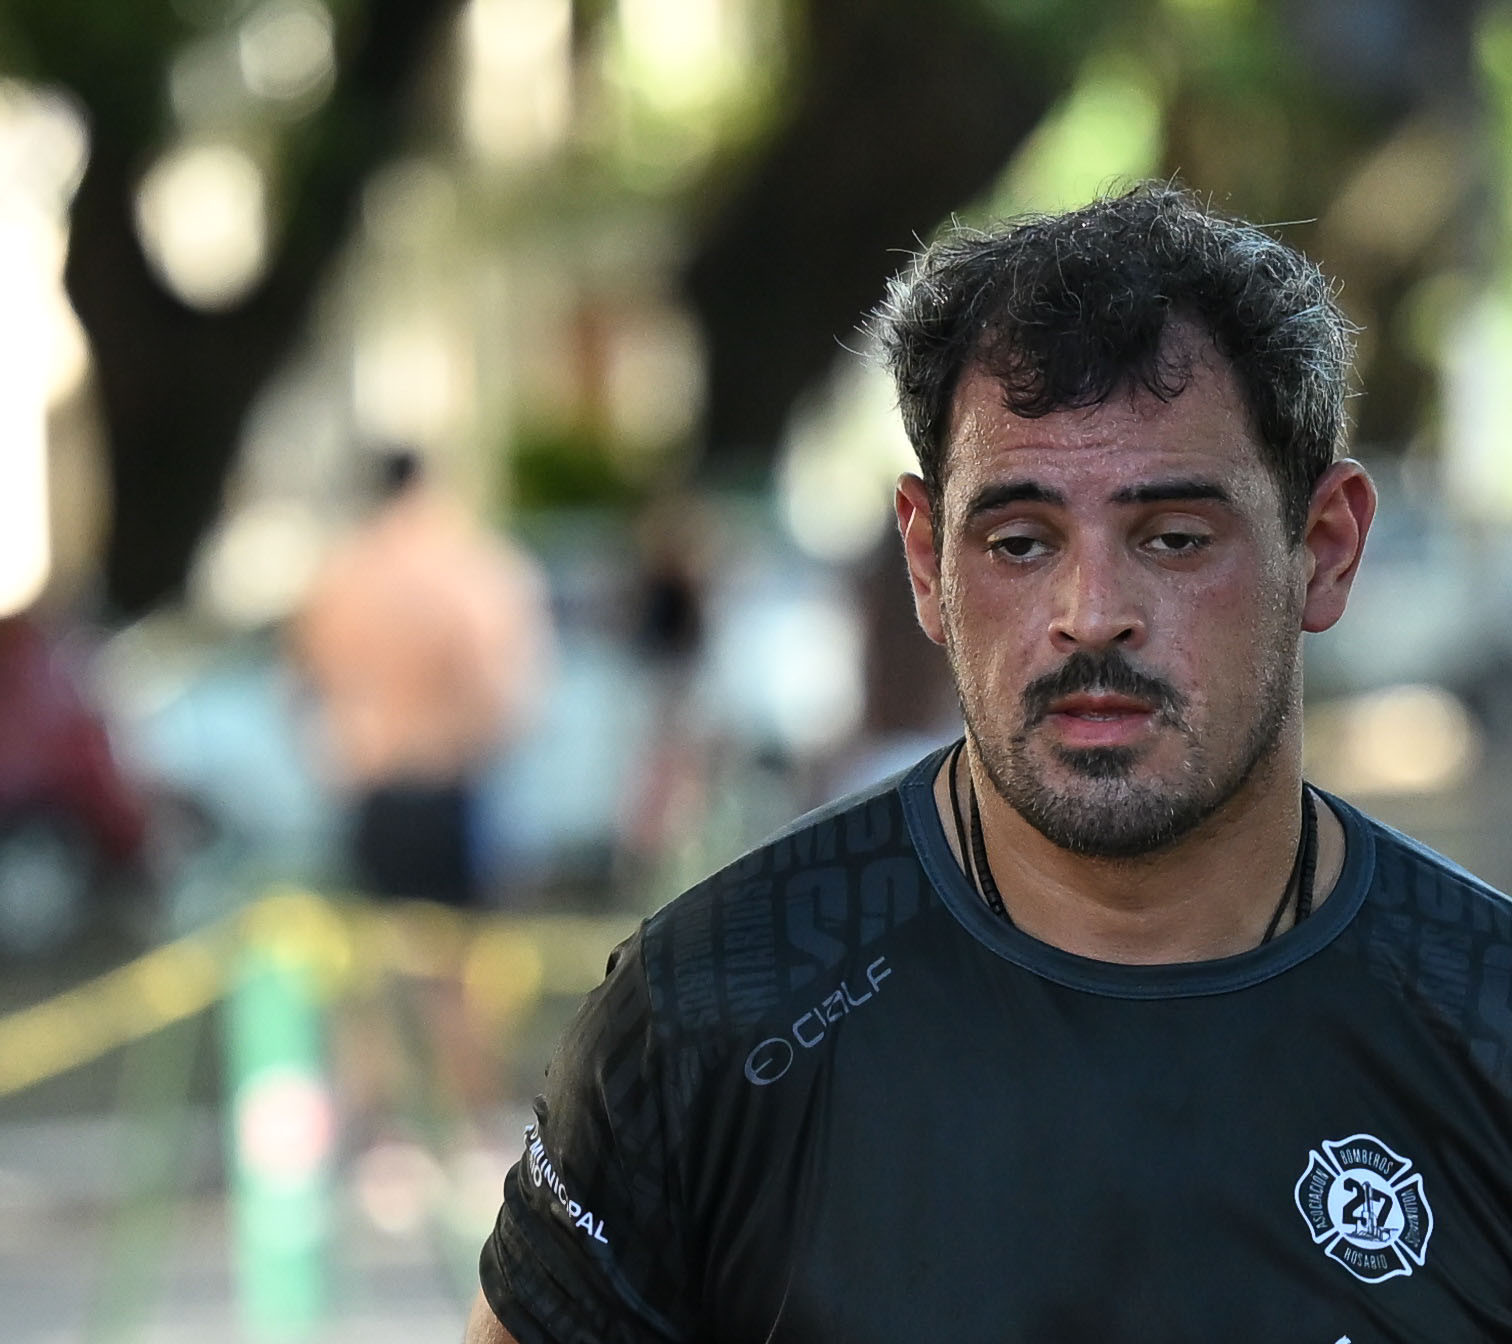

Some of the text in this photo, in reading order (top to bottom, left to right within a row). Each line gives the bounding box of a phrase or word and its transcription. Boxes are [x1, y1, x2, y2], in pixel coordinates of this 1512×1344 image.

[1340, 1148, 1394, 1175] BOMBEROS
[530, 1136, 609, 1244] MUNICPAL
[1343, 1177, 1393, 1227] 27
[1344, 1247, 1388, 1270] ROSARIO
